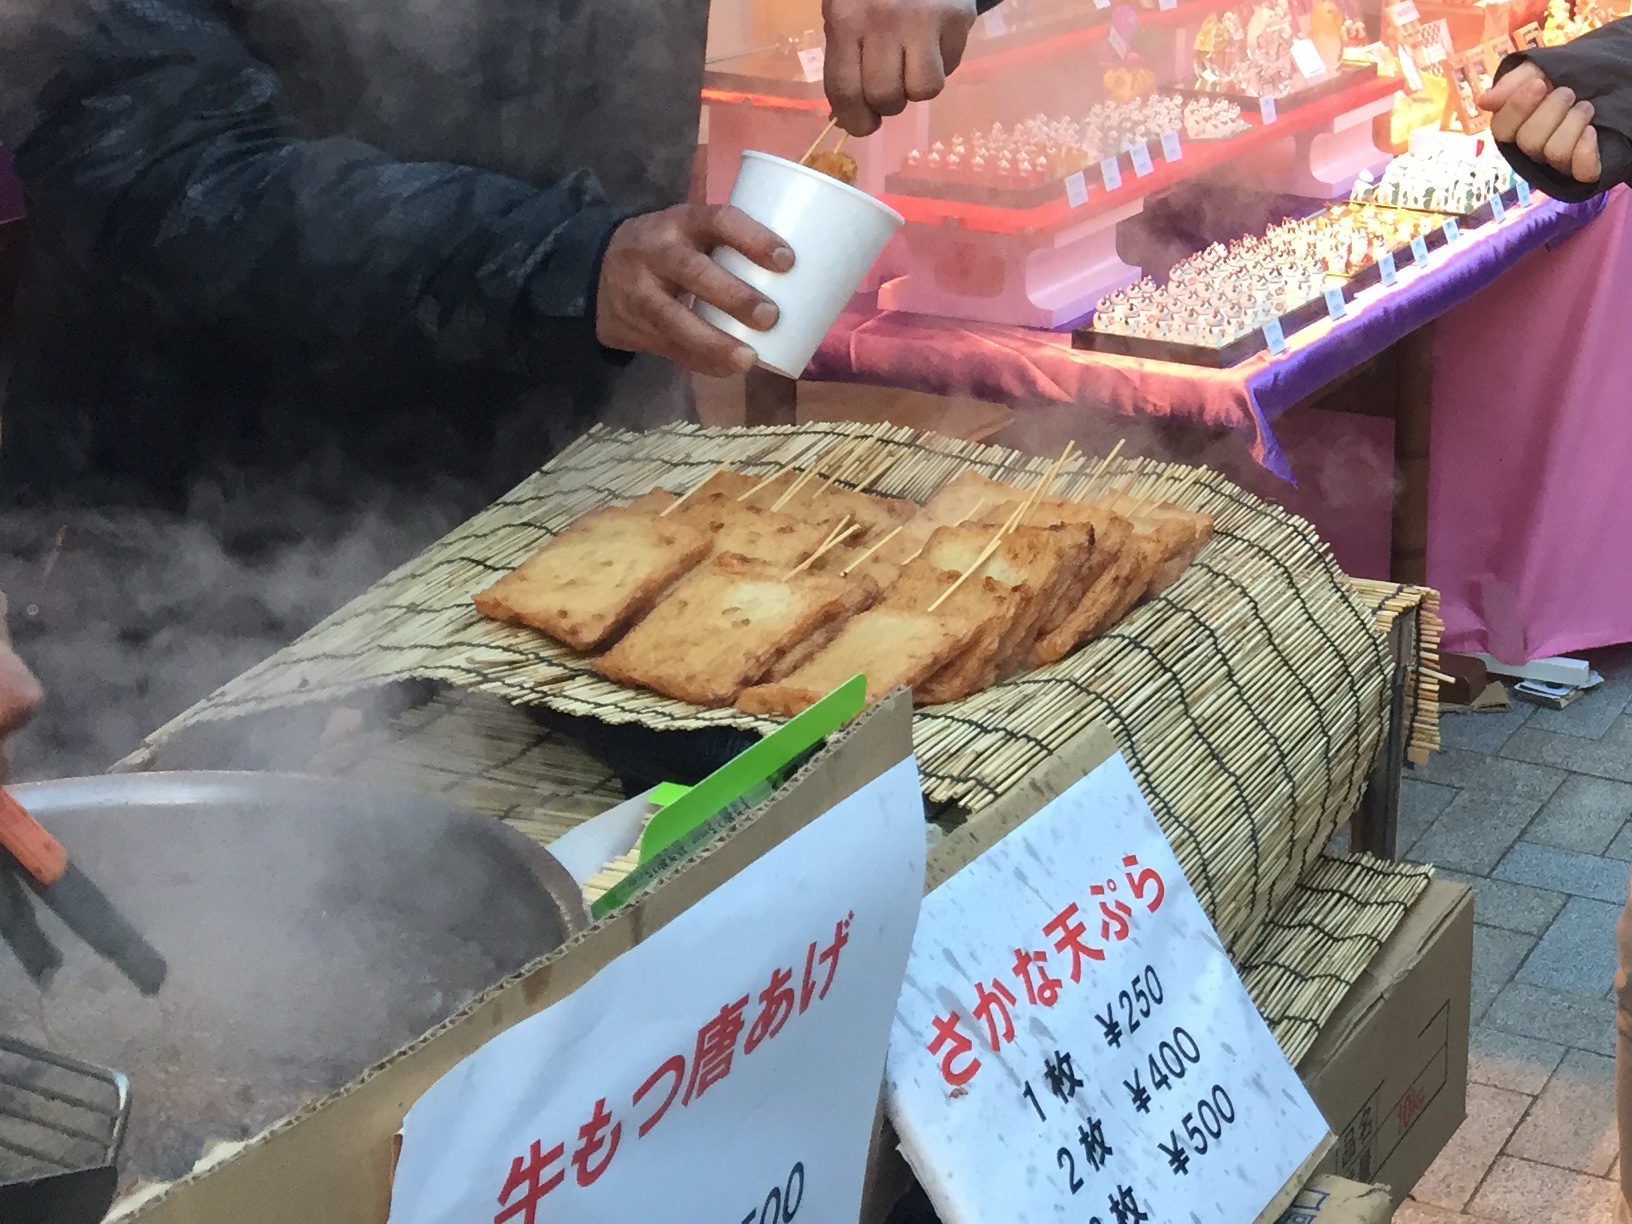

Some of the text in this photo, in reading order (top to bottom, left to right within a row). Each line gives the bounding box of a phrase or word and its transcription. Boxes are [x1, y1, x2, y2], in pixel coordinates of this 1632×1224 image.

[926, 854, 1166, 1087] さかな天ぷら
[1094, 964, 1163, 1049] ¥250
[494, 909, 855, 1224] 牛もつ唐あげ
[1122, 1027, 1201, 1115] ¥400
[741, 1161, 804, 1224] 00
[1088, 1084, 1235, 1224] 枚 ¥500
